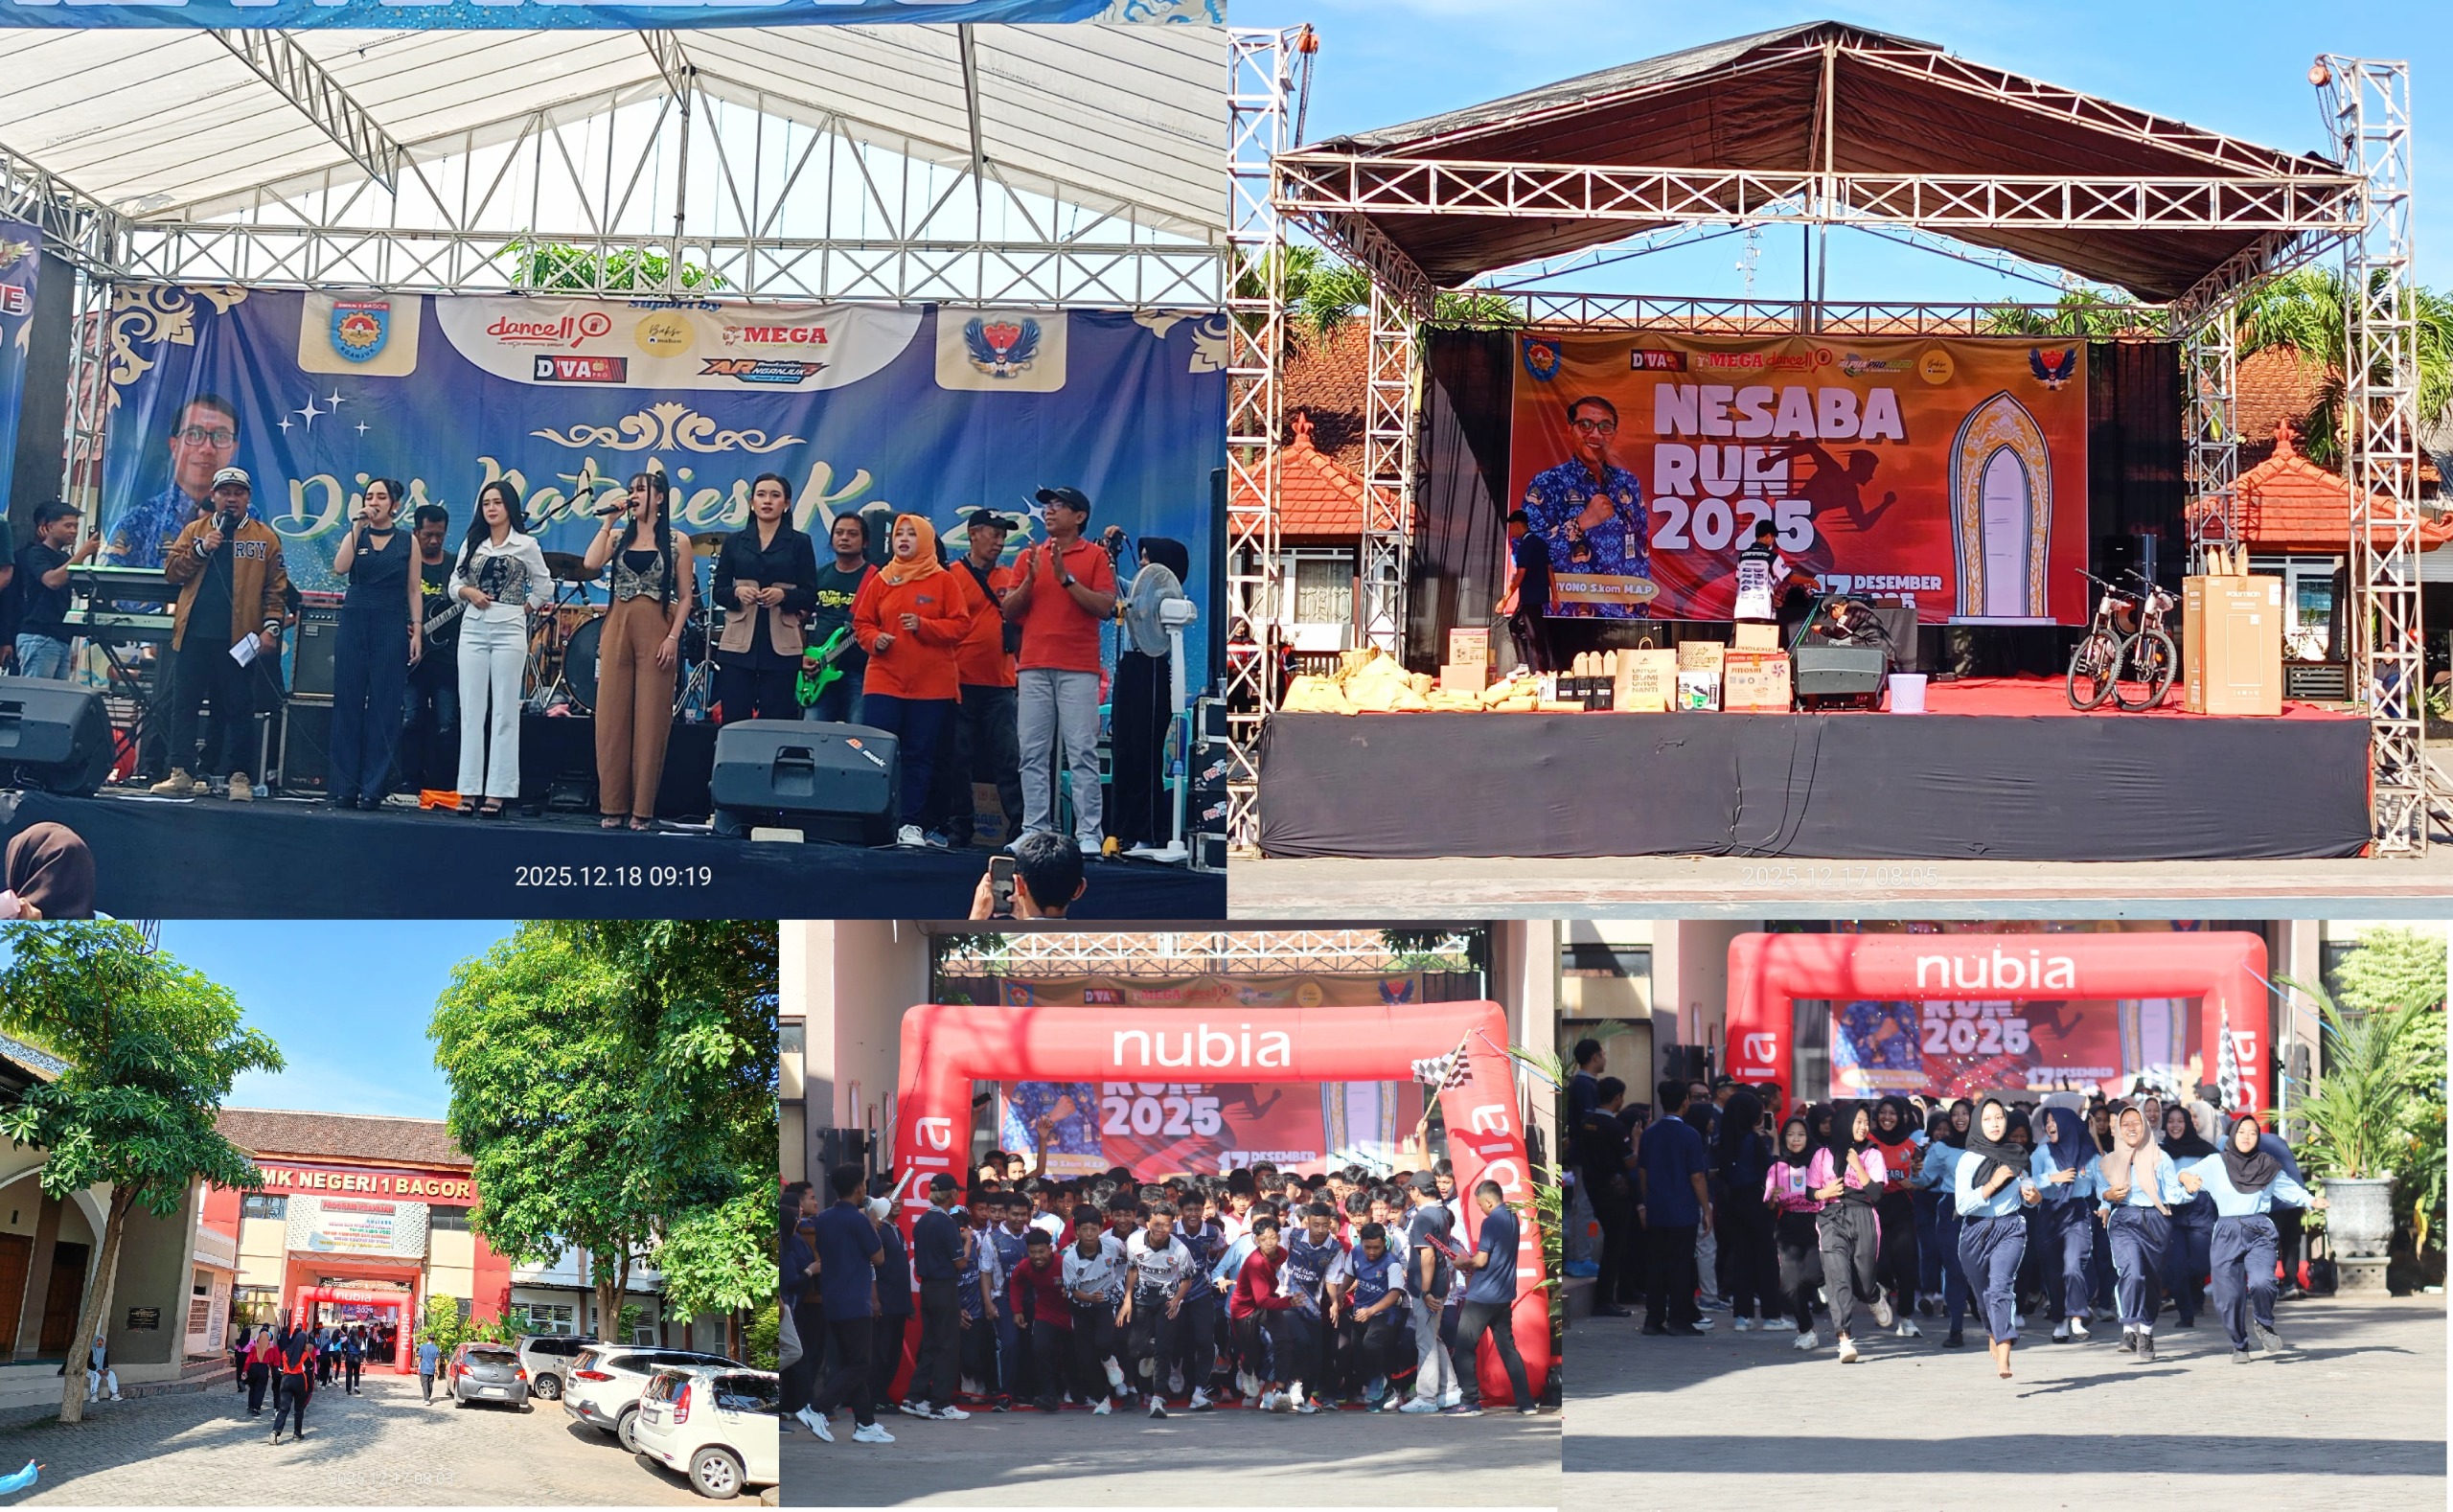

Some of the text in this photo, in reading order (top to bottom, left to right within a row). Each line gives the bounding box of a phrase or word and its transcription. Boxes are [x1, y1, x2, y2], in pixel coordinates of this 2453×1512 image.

[487, 316, 575, 338] dancell
[744, 327, 829, 344] MEGA
[340, 346, 376, 359] NGANJUK
[1709, 353, 1764, 368] MEGA
[1766, 349, 1813, 368] dancell
[537, 359, 582, 378] D'VA
[752, 367, 806, 376] NGANJUK
[1654, 383, 1904, 440] NESABA
[1654, 444, 1789, 497] RUN
[270, 473, 445, 537] Dis
[791, 460, 891, 536] K
[1651, 496, 1815, 553] 2025
[1590, 584, 1621, 594] S.kom
[1854, 576, 1942, 590] DESEMBER
[1916, 949, 2075, 990] nubia
[1113, 1023, 1291, 1067] nubia
[1922, 1019, 2030, 1054] 2025
[1103, 1096, 1222, 1136] 2025
[1250, 1152, 1317, 1163] DESEMBER
[263, 1169, 471, 1200] MK NEGERI 1 BAGOR
[335, 1291, 372, 1302] nubia
[401, 1313, 411, 1350] nubia
